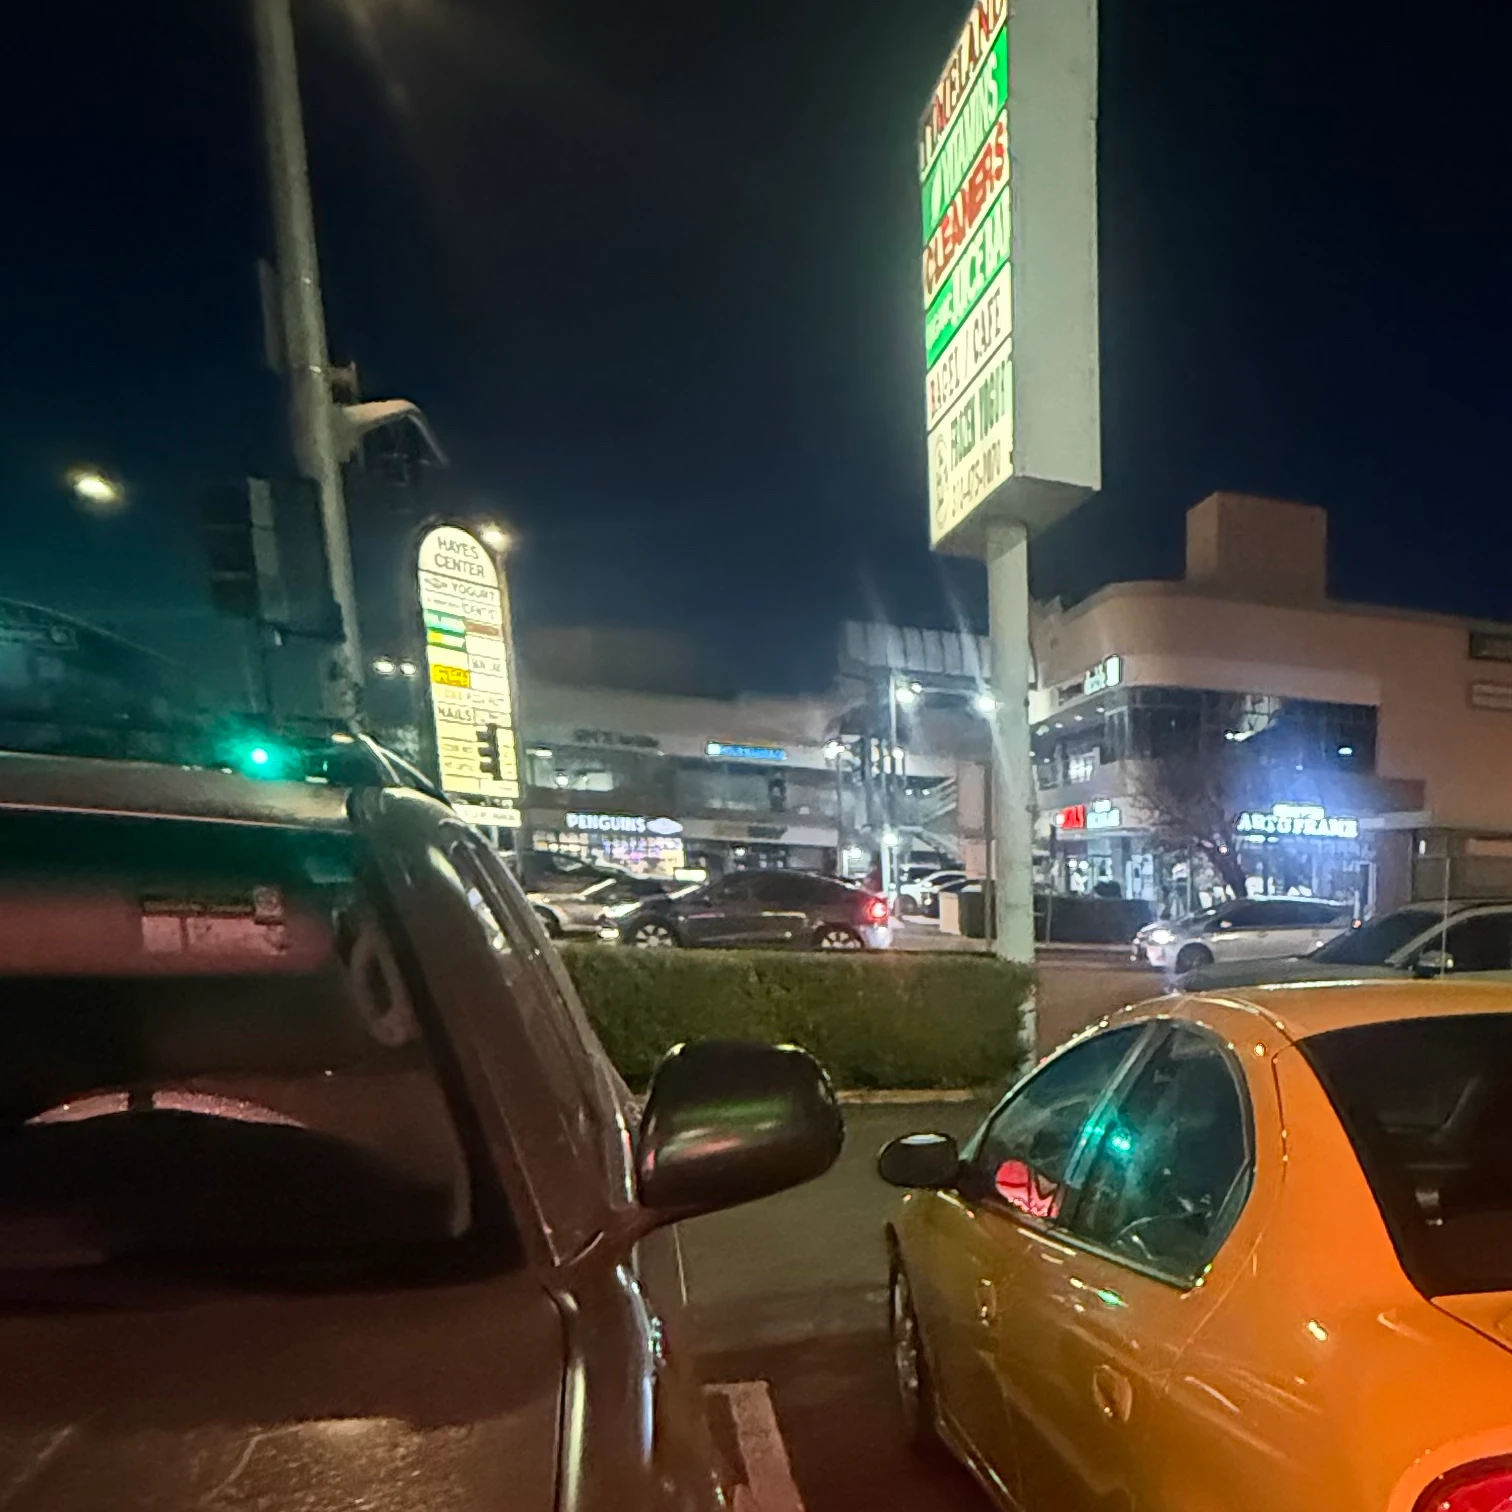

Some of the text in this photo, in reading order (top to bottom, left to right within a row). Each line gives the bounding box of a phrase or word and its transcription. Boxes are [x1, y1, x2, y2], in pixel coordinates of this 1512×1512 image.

[940, 51, 998, 201] VITAMINS
[926, 122, 1004, 294] CLEANERS
[973, 287, 1001, 364] CAFE
[434, 552, 485, 578] CENTER
[437, 537, 479, 560] HAYES
[566, 812, 646, 834] PENGUINS
